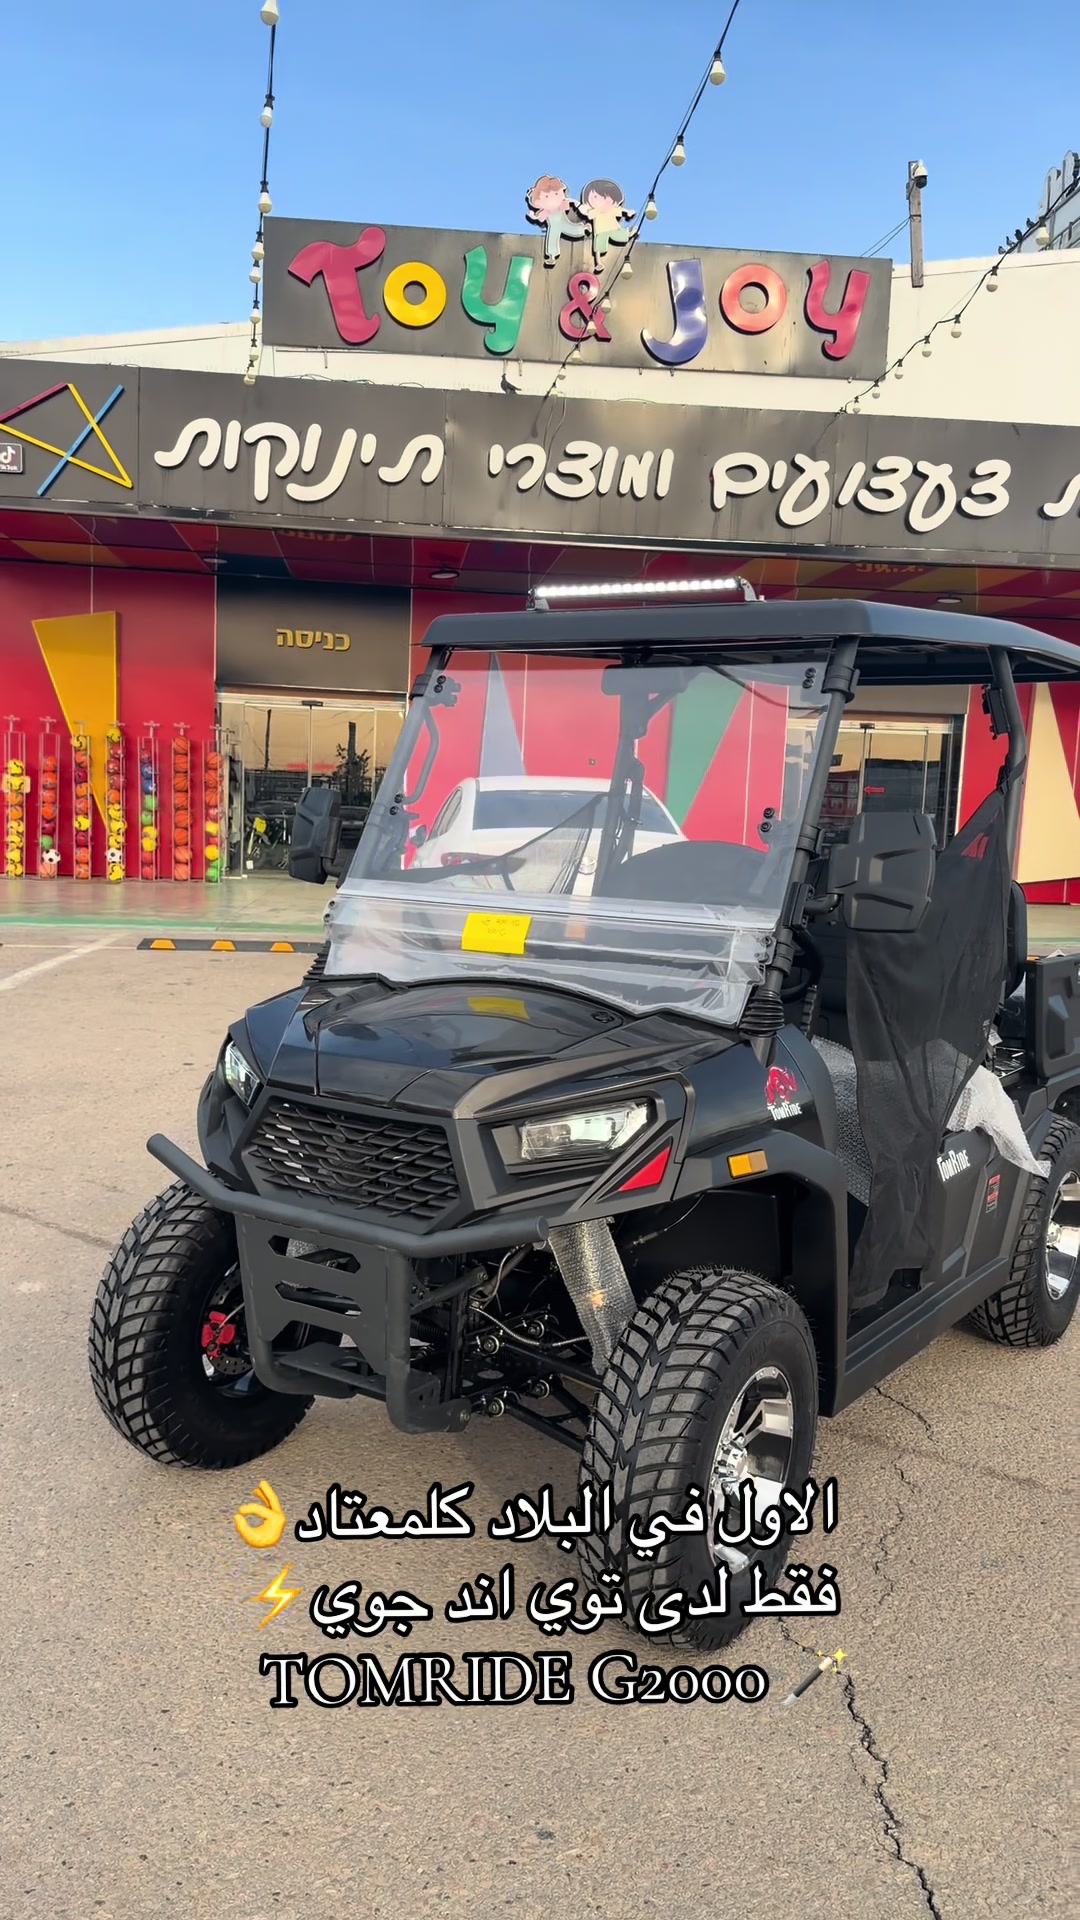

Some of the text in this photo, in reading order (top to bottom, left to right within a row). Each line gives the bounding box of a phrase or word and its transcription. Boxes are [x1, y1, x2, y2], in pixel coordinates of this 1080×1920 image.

[559, 272, 612, 343] &
[154, 417, 445, 502] תינוקות
[488, 440, 675, 500] ומוצרי
[711, 451, 1012, 534] צעצועים
[276, 628, 352, 651] כניסה
